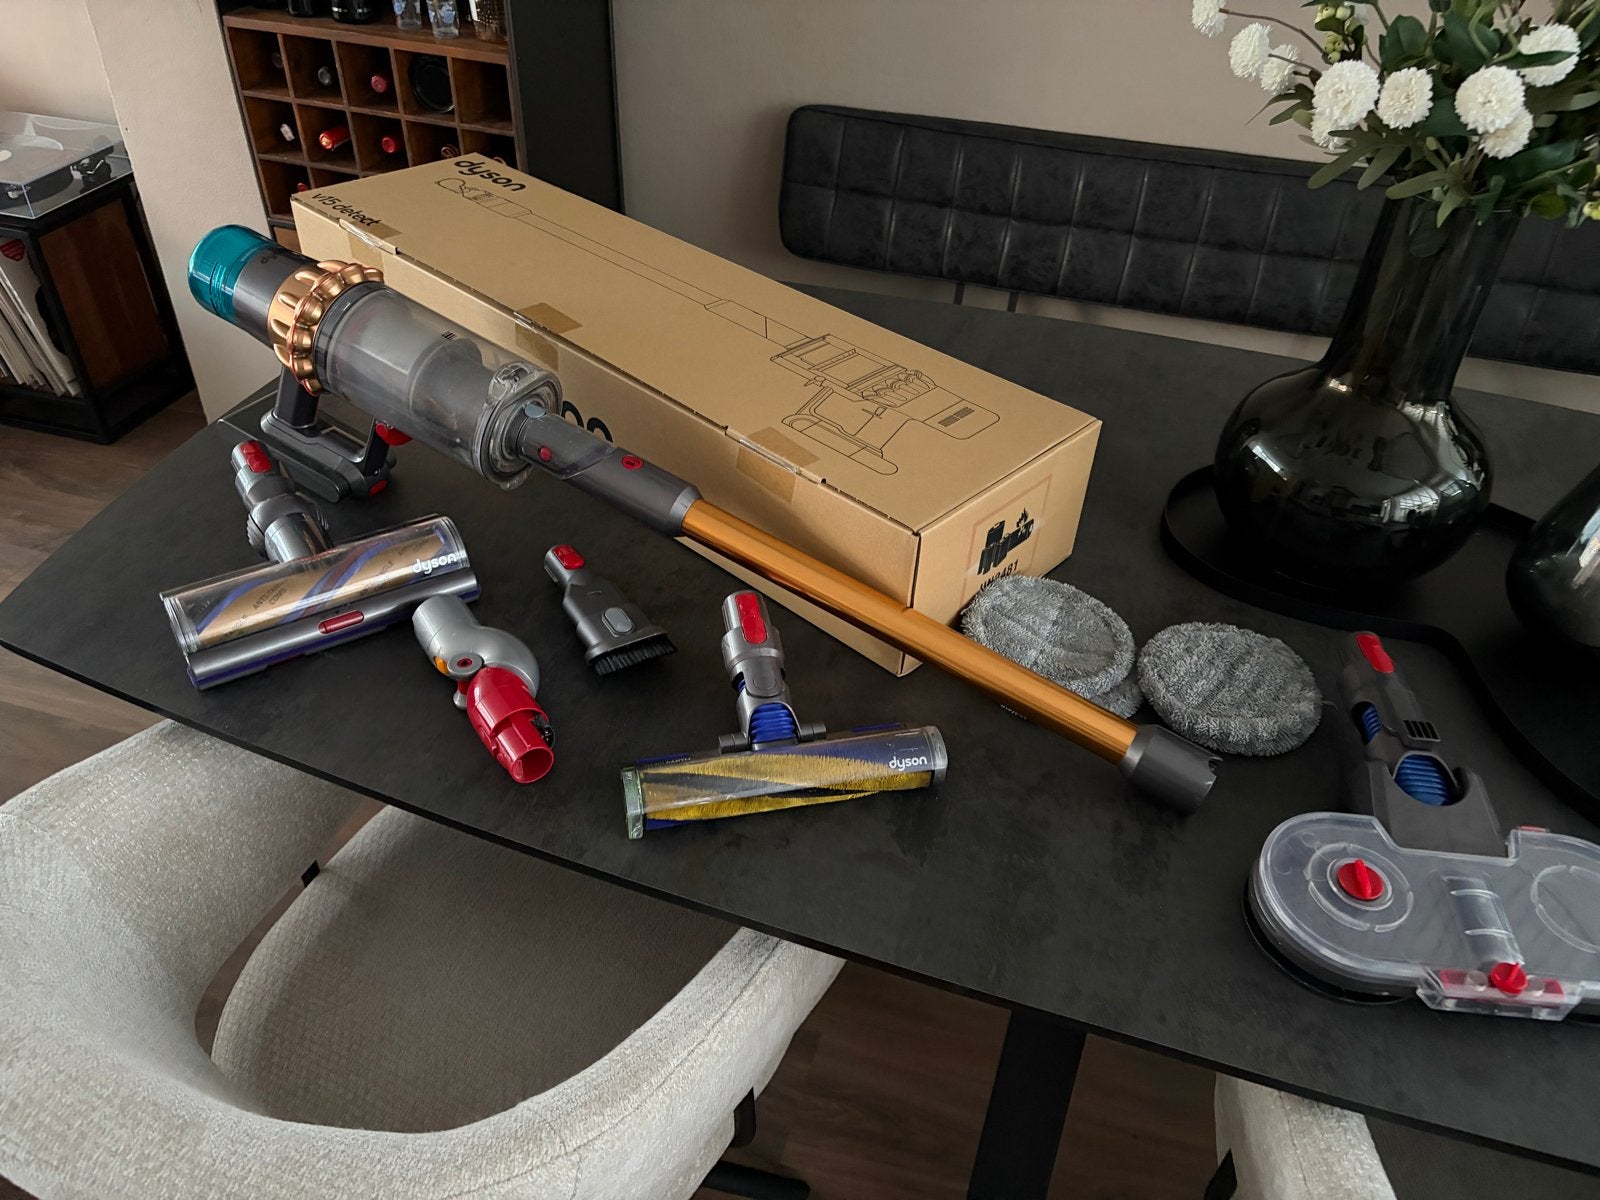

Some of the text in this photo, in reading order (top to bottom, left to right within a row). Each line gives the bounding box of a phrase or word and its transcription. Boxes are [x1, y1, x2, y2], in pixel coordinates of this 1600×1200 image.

[454, 160, 526, 192] dyson
[311, 193, 382, 227] v15 detect
[412, 552, 459, 575] dyson
[888, 755, 928, 772] dyson
